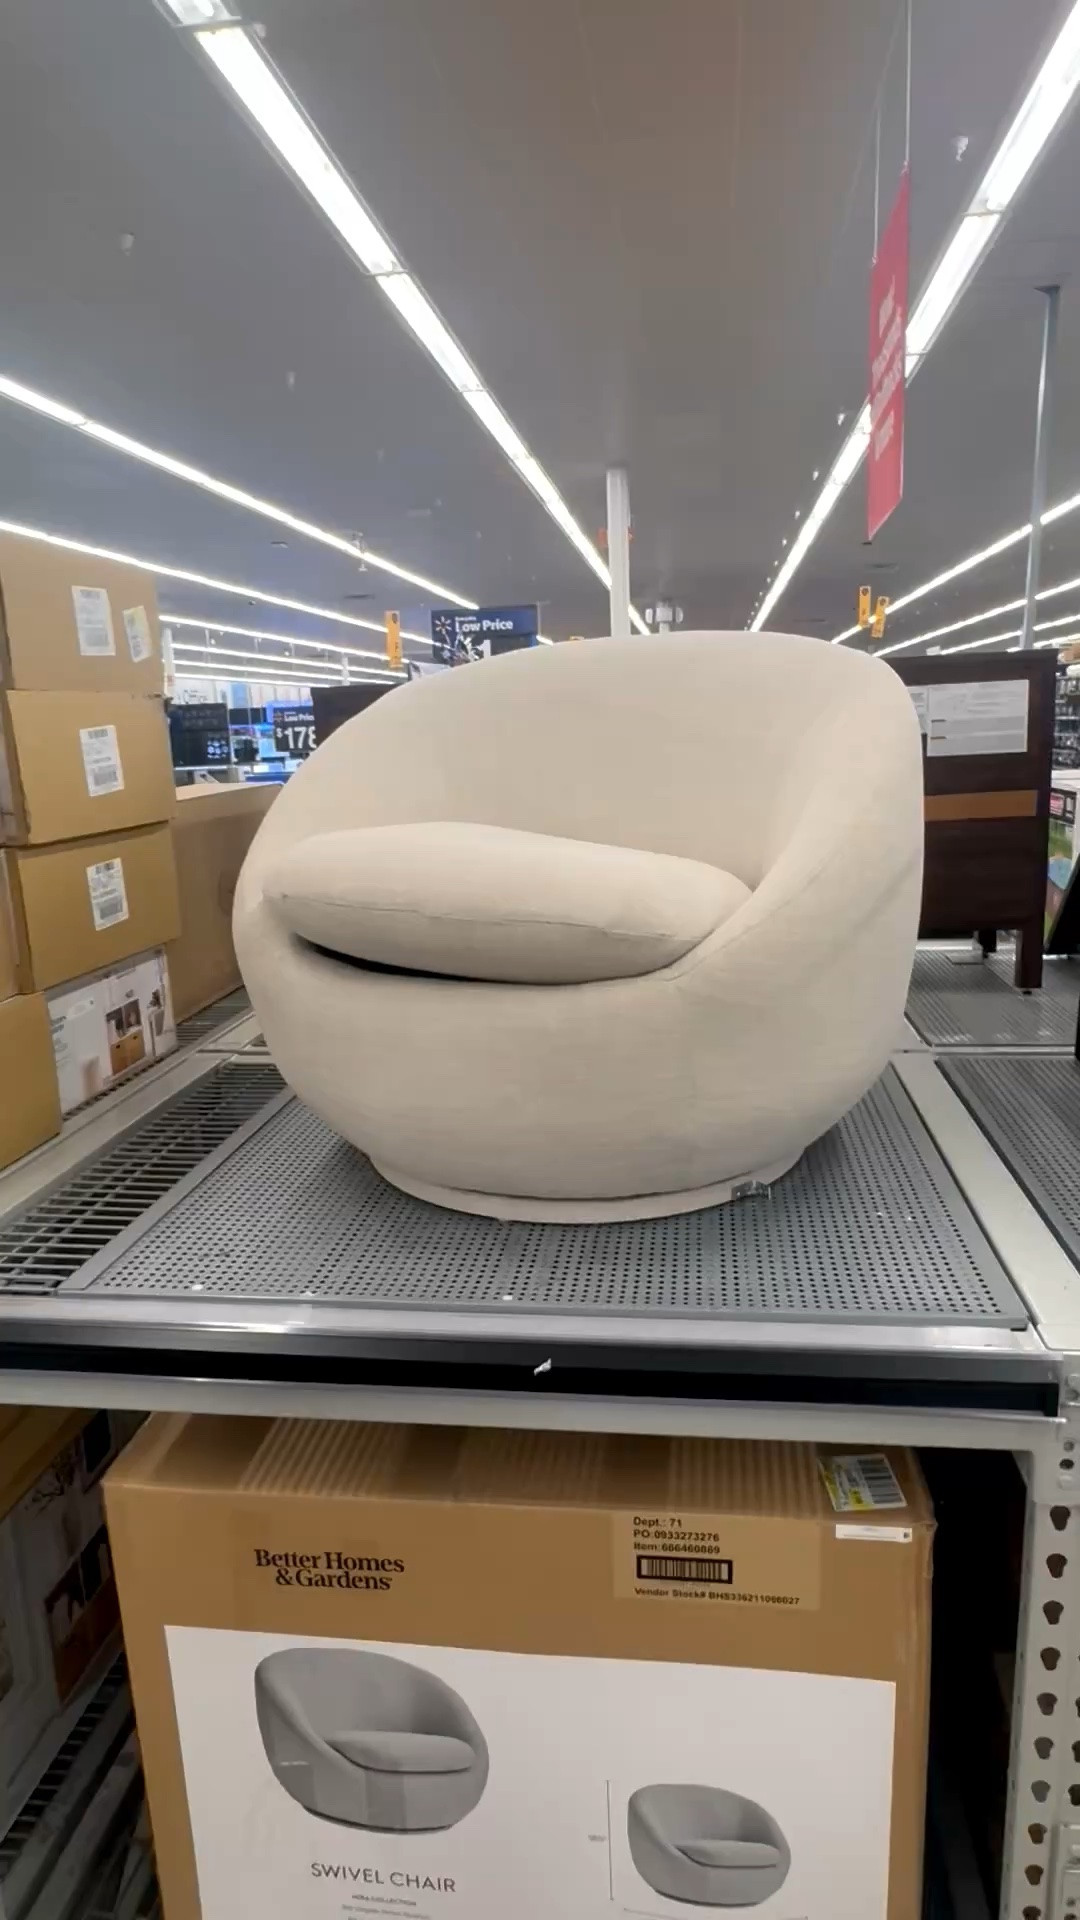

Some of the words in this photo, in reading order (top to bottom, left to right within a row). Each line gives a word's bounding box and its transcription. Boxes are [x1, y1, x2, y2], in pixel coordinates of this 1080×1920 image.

[455, 620, 481, 633] Low
[482, 618, 514, 631] Price
[669, 1518, 682, 1528] 71
[254, 1548, 322, 1570] Better
[324, 1551, 405, 1573] Homes
[275, 1567, 294, 1586] &
[295, 1569, 392, 1591] Gardens
[634, 1587, 669, 1597] Vendor
[672, 1588, 706, 1598] Stock#
[310, 1862, 385, 1885] SWIVEL
[389, 1871, 457, 1893] CHAIR
